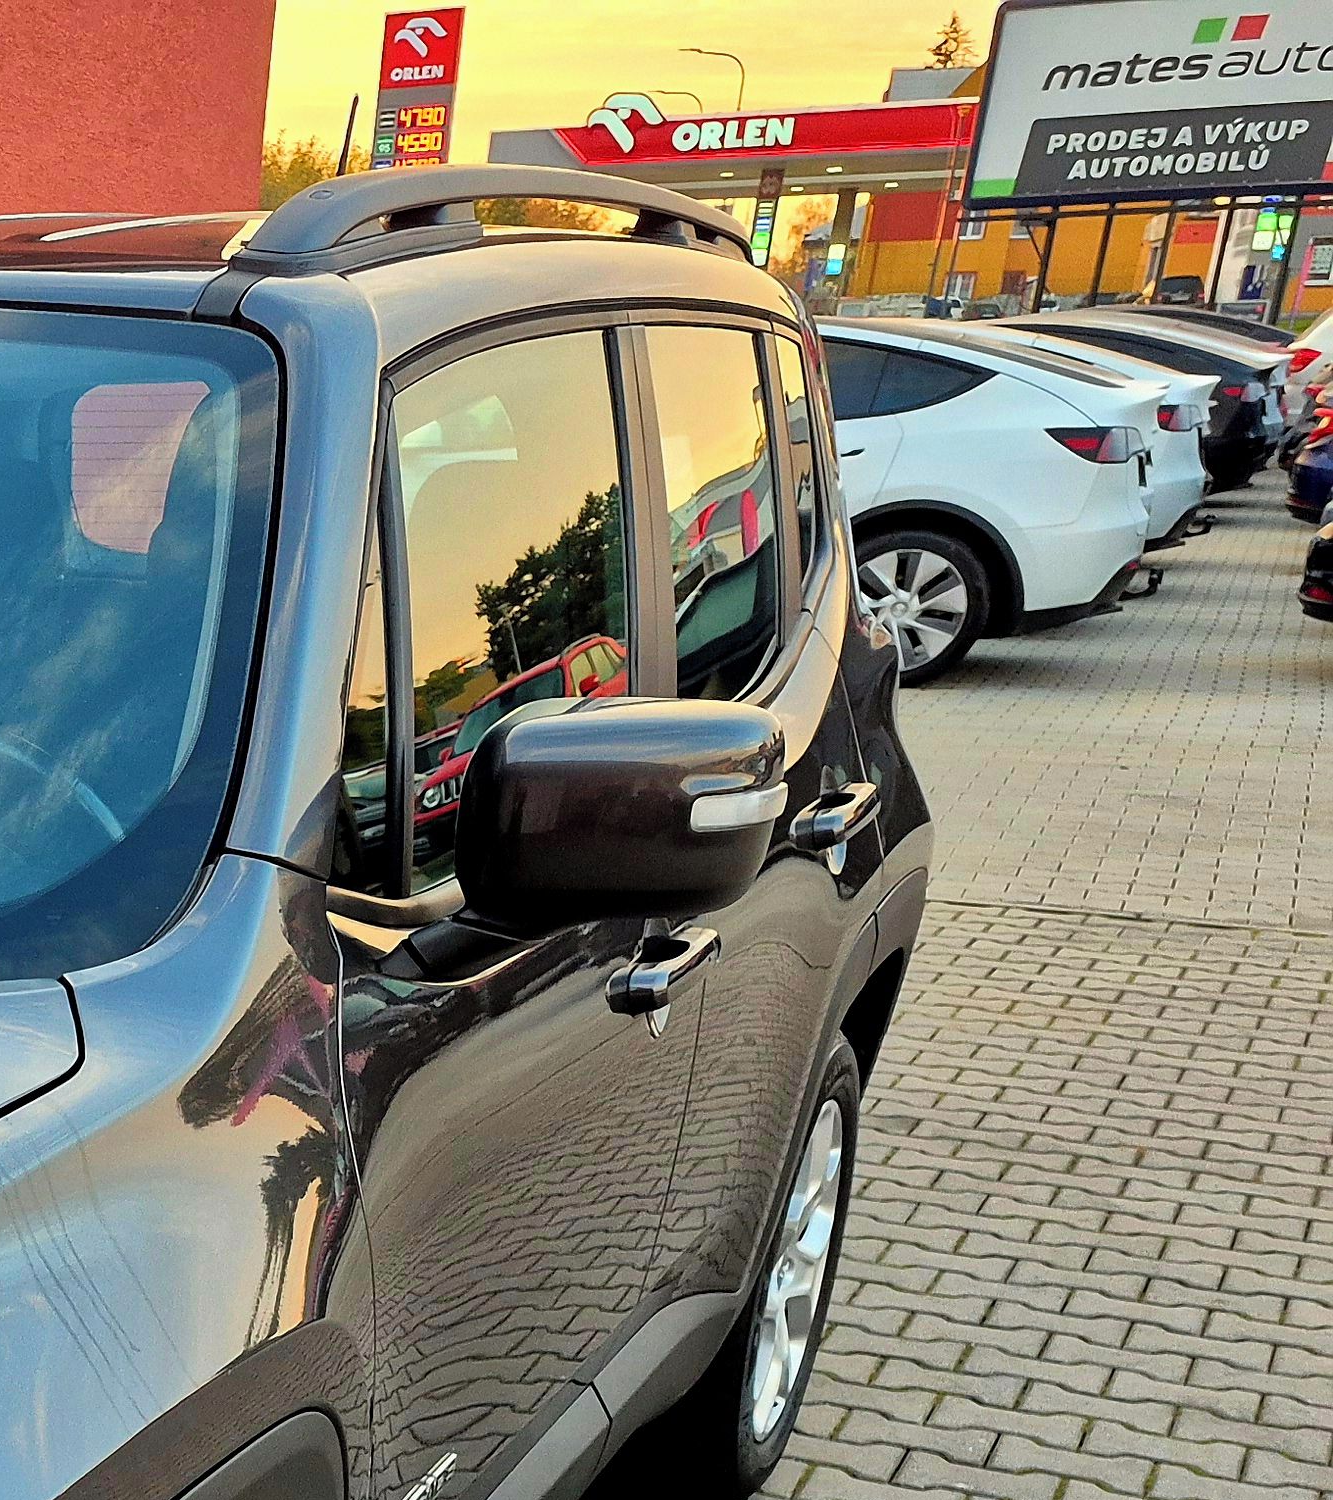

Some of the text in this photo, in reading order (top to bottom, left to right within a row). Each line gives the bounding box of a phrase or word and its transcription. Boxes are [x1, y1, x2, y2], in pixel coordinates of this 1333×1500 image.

[390, 65, 445, 82] ORLEN
[1041, 53, 1213, 91] mates
[399, 106, 447, 128] 4790
[671, 117, 795, 152] ORLEN
[397, 131, 443, 153] 4590
[1046, 117, 1310, 155] PRODEJ A VÝKUP
[1066, 144, 1270, 180] AUTOMOBILŮ
